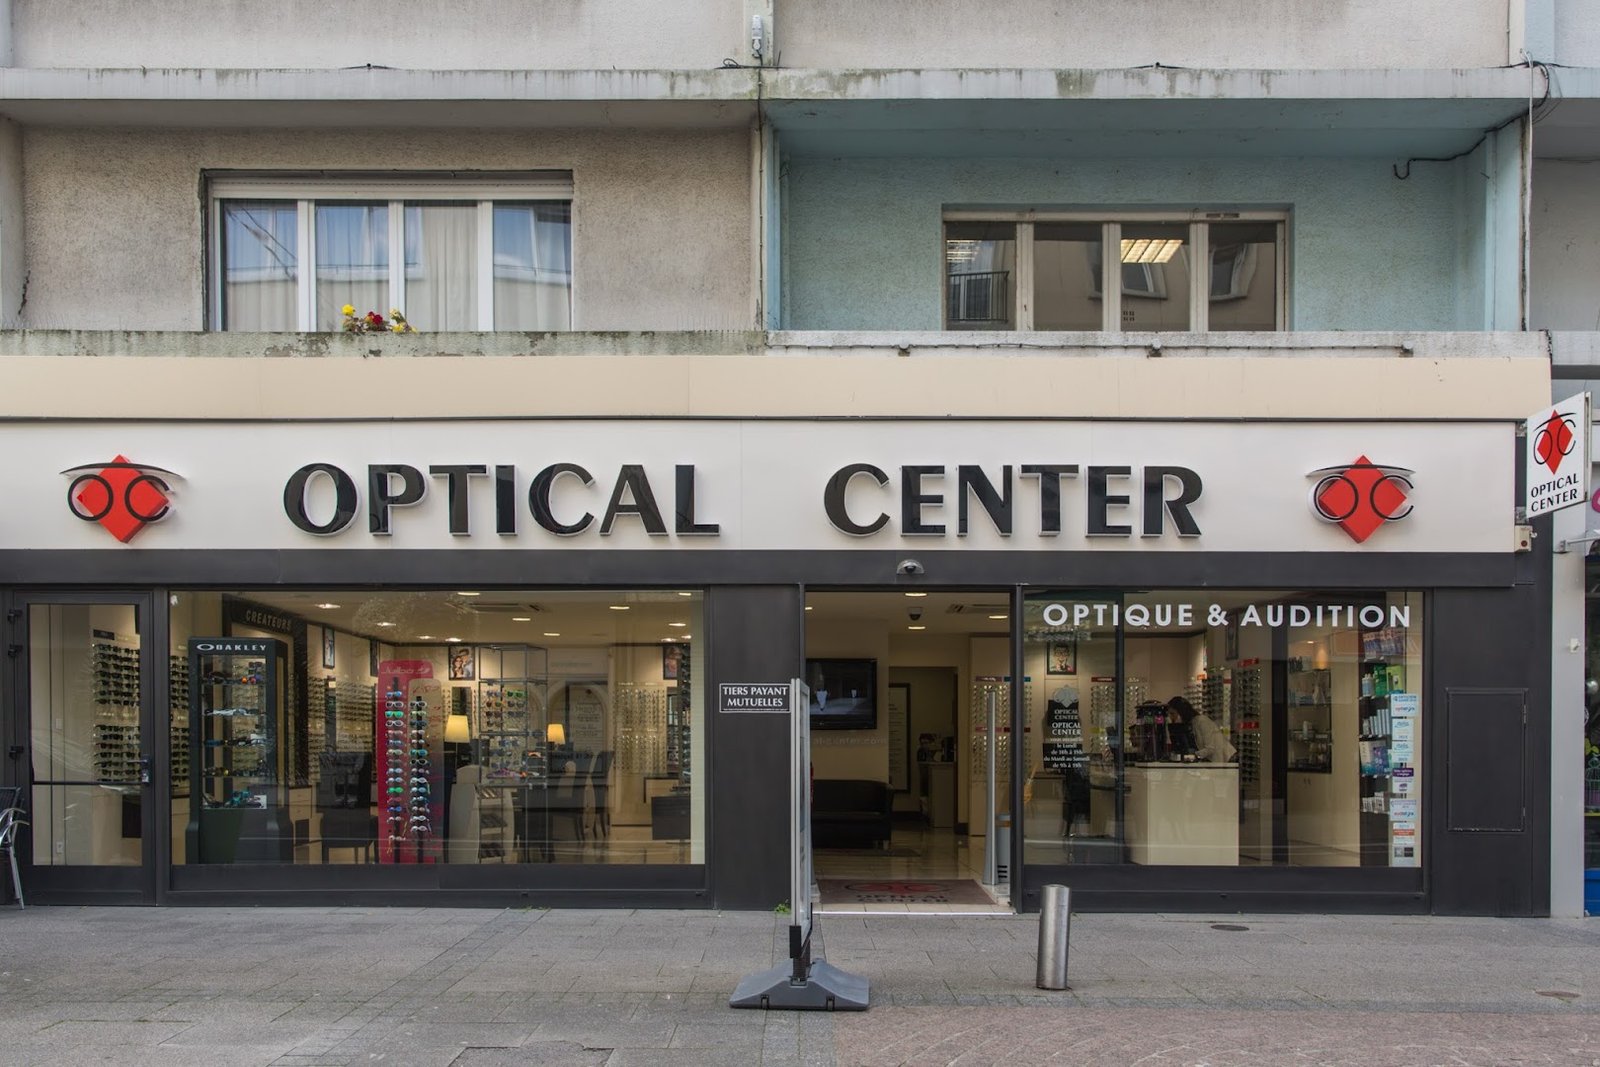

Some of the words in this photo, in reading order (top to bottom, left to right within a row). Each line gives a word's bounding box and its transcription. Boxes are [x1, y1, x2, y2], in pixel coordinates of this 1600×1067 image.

[1530, 472, 1580, 499] OPTICAL
[283, 462, 720, 537] OPTICAL
[824, 462, 1203, 537] CENTER
[1530, 487, 1579, 513] CENTER
[1042, 602, 1194, 629] OPTIQUE
[1207, 603, 1230, 628] &
[1240, 603, 1412, 629] AUDITION
[722, 686, 748, 696] TIERS
[750, 686, 788, 696] PAYANT
[727, 697, 783, 707] MUTUELLES
